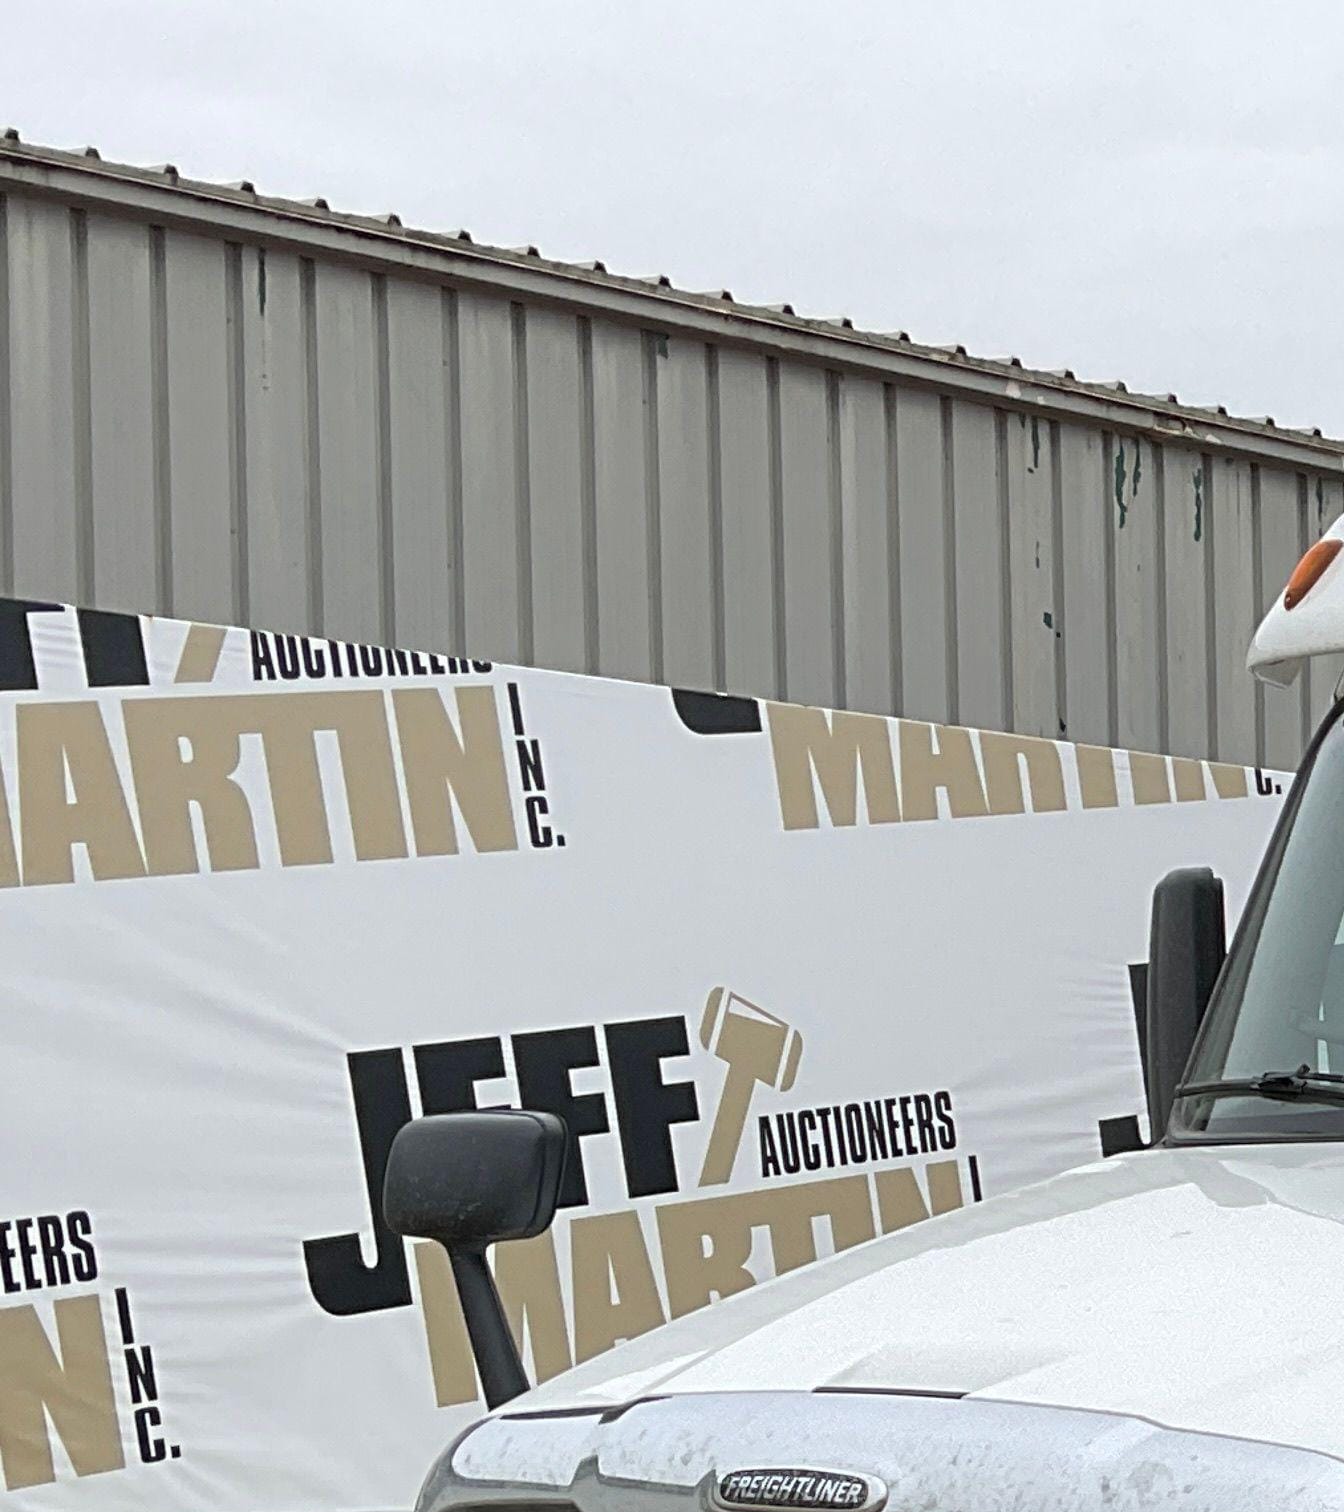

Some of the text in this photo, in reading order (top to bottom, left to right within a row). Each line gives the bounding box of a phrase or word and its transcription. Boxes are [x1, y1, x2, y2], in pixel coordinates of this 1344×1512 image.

[0, 686, 518, 887] ARTIN
[758, 1091, 957, 1178] AUCTIONEERS
[115, 1287, 182, 1464] INC.
[724, 1475, 864, 1504] FREIGHTLINER
